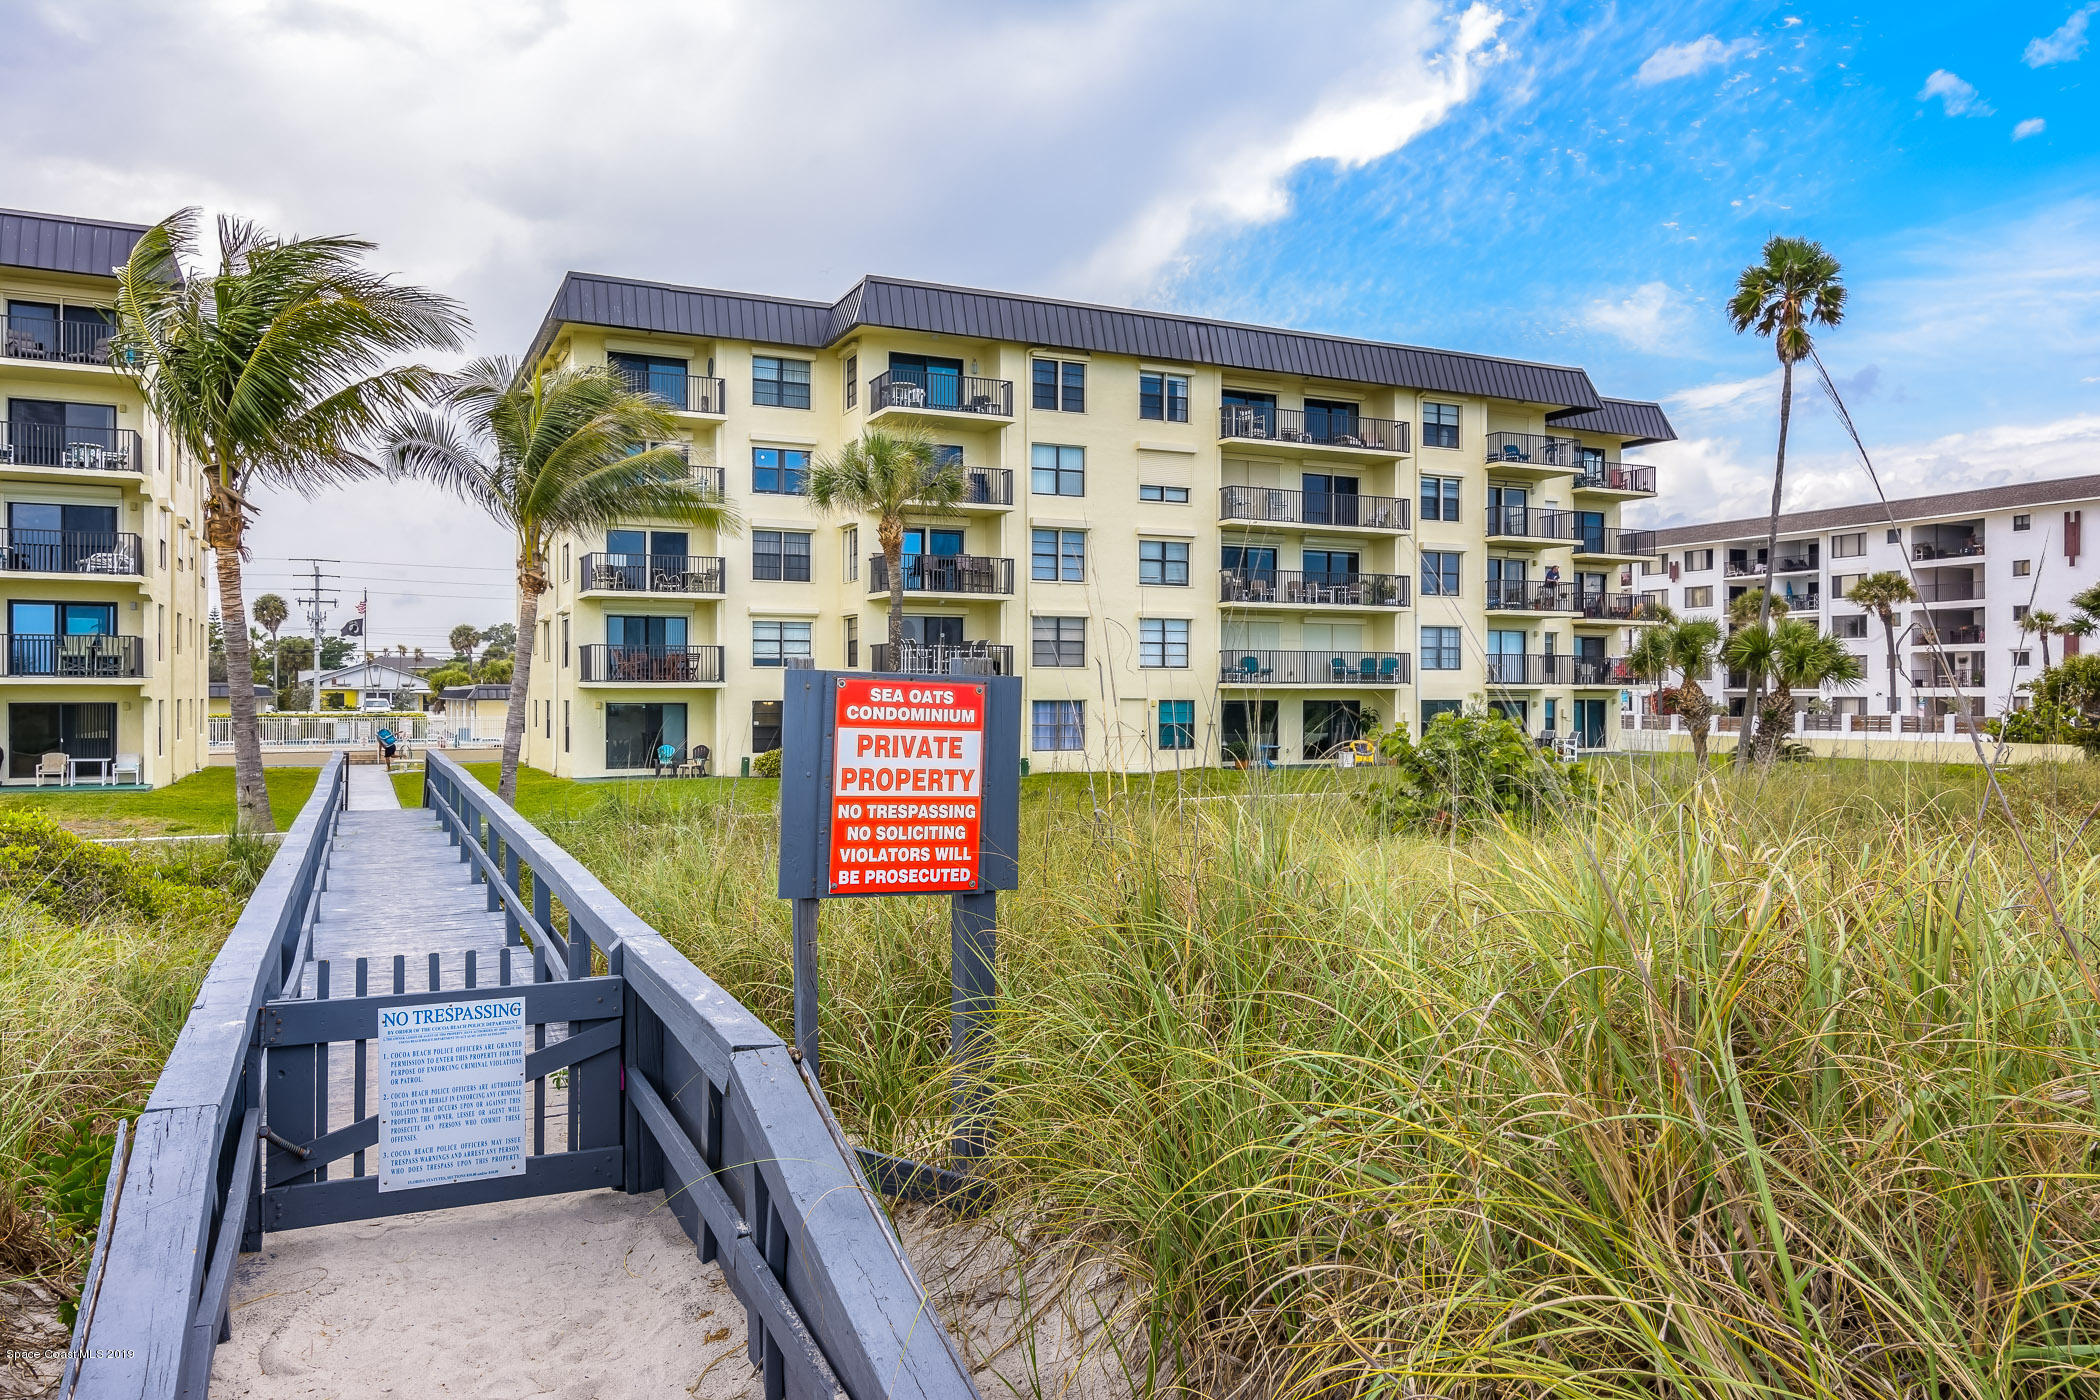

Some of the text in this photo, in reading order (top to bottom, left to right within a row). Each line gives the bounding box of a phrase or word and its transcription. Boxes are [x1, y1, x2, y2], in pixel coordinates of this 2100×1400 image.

[870, 688, 954, 704] SEA OATS
[846, 706, 975, 723] CONDOMINIUM
[857, 734, 963, 759] PRIVATE
[841, 767, 975, 792] PROPERTY
[838, 805, 976, 819] NO TRESPASSING
[847, 825, 966, 841] NO SOLICITING
[839, 847, 971, 863] VIOLATORS WILL
[838, 868, 971, 885] BE PROSECUTED
[384, 1002, 521, 1027] NO TRESPASSING
[497, 1041, 522, 1049] GRANTED
[391, 1059, 424, 1067] PERMISSION
[470, 1052, 497, 1060] PROPERTY
[427, 1064, 458, 1072] ENFORCING
[461, 1061, 488, 1069] CRIMINAL
[490, 1058, 522, 1066] VIOLATIONS
[452, 1085, 476, 1093] OFFICERS
[491, 1081, 522, 1089] AUTHORIZED
[457, 1093, 485, 1101] ENFORCING
[391, 1109, 418, 1117] VIOLATION
[438, 1104, 457, 1112] OCCURS
[391, 1126, 420, 1134] PROSECUTE
[391, 1150, 410, 1158] COCOA
[415, 1147, 433, 1155] BEACH
[461, 1141, 487, 1149] OFFICERS
[391, 1158, 418, 1166] TRESPASS
[420, 1154, 449, 1163] WARNINGS
[499, 1145, 519, 1153] PERSON
[427, 1162, 453, 1170] TRESPASS
[492, 1154, 521, 1162] PROPERTY.
